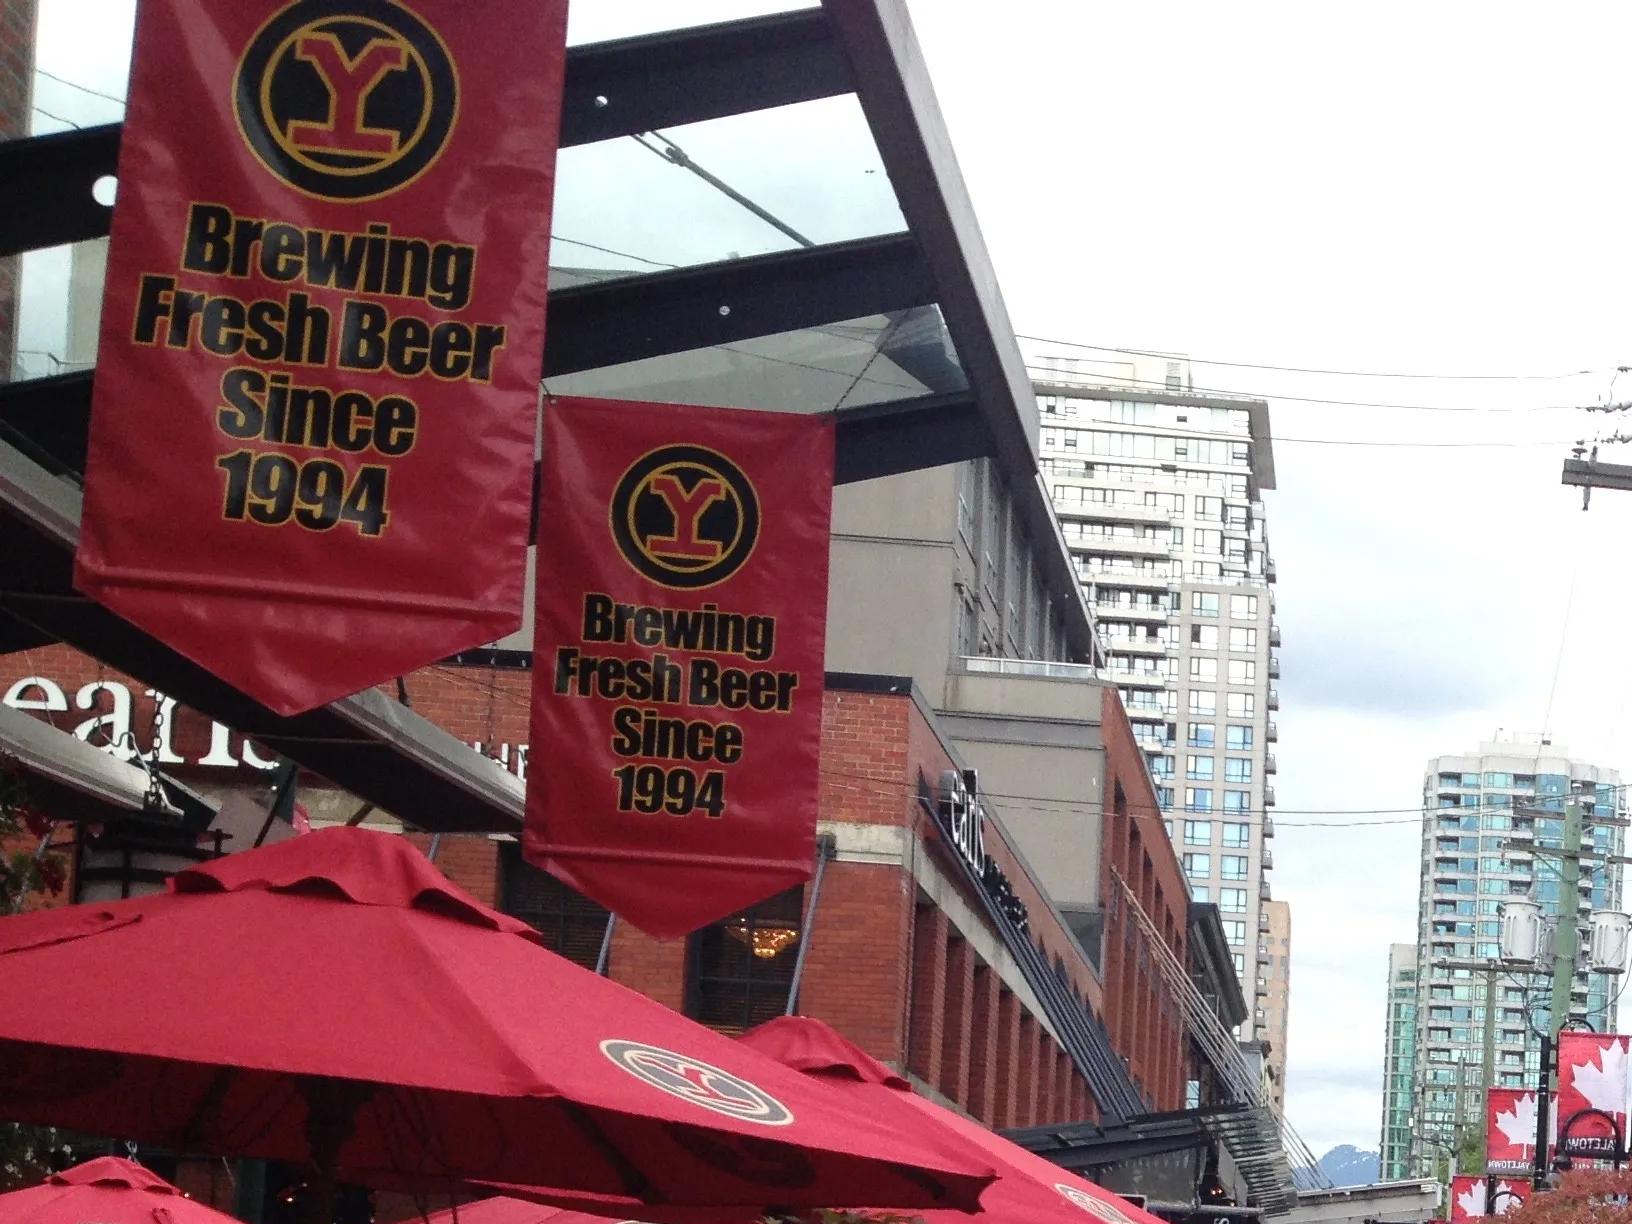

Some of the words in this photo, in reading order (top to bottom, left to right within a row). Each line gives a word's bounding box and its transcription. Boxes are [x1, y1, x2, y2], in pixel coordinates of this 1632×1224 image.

[184, 204, 475, 310] Brewing
[132, 274, 332, 366] Fresh
[336, 297, 506, 383] Beer
[217, 369, 418, 457] Since
[217, 450, 391, 538] 1994
[582, 594, 776, 661] Brewing
[553, 651, 684, 705] Fresh
[687, 667, 799, 714] Beer
[611, 706, 743, 764] Since
[613, 765, 725, 819] 1994
